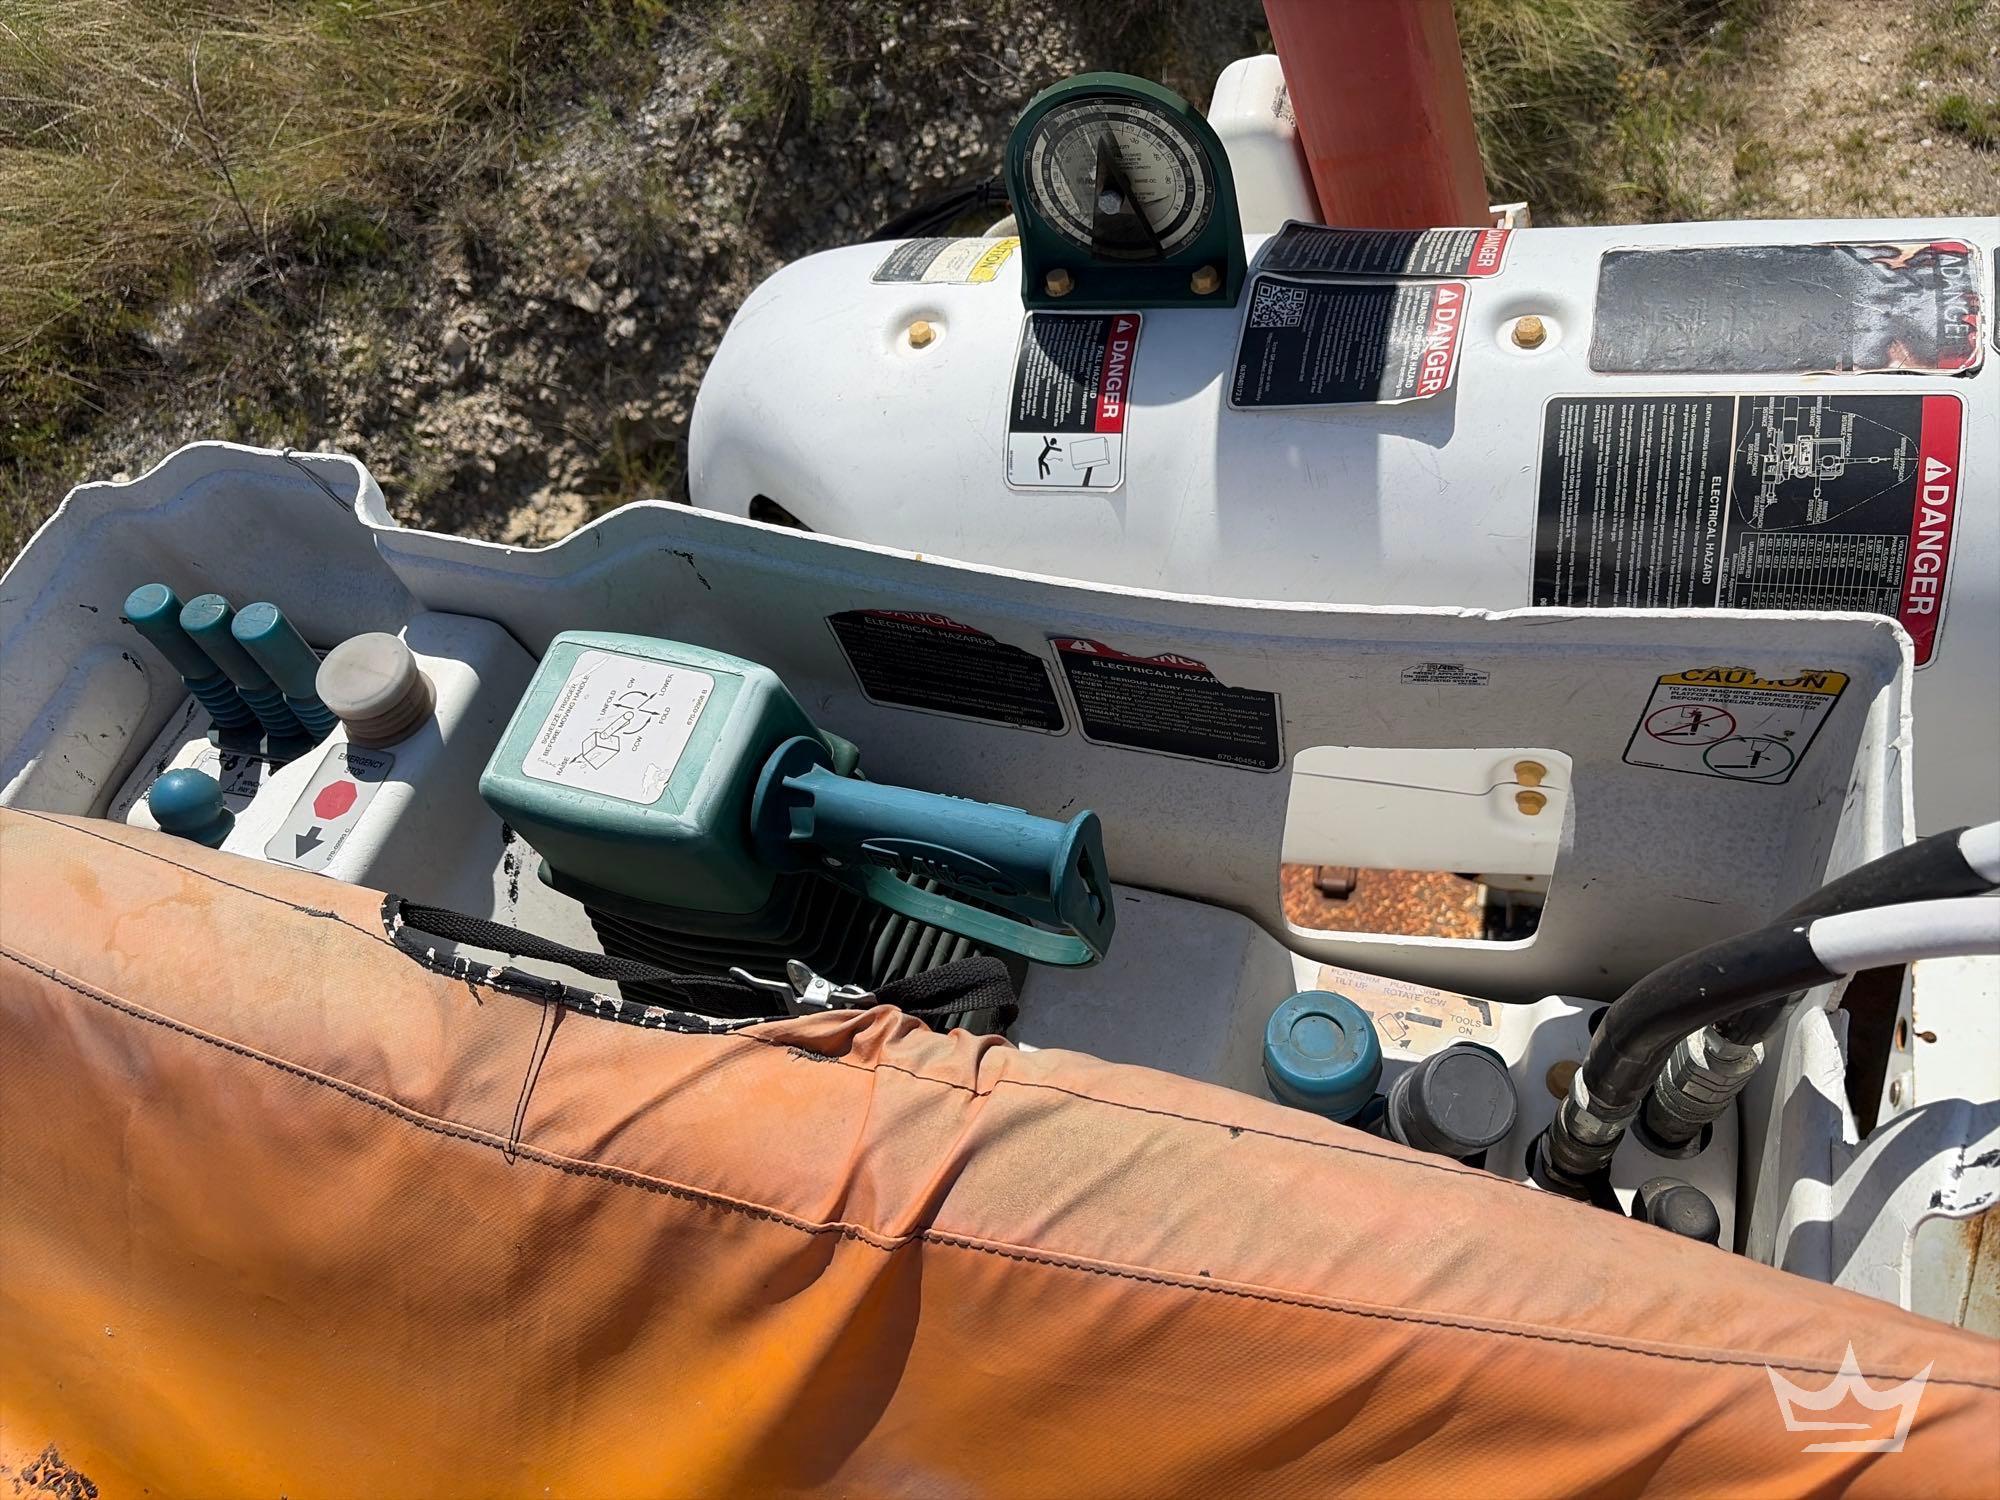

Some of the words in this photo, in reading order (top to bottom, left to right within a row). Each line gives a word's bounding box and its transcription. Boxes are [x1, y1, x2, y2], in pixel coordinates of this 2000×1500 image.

[1415, 291, 1431, 323] UNTRAINED
[1941, 267, 1969, 340] DANGE
[1094, 345, 1104, 363] FALL
[1420, 308, 1457, 394] DANGER
[1088, 365, 1100, 398] HAZARD
[1101, 340, 1129, 418] DANGER
[1403, 361, 1418, 388] HAZARD
[1705, 475, 1722, 540] ELECTRICAL
[1907, 485, 1950, 614] DANGER
[1700, 542, 1715, 584] HAZARD
[864, 616, 934, 635] ELECTRICAL
[1092, 660, 1172, 679] ELECTRICAL
[1174, 672, 1220, 684] HAZAR
[1109, 675, 1149, 685] SERIOUS
[1680, 670, 1829, 689] CAUON
[625, 676, 637, 689] CW
[657, 673, 675, 696] LOWER
[598, 689, 618, 716] UNFOLD
[1754, 691, 1790, 699] DAMAGE
[1793, 693, 1829, 702] RETURN
[1756, 701, 1816, 710] OVERCENTER
[539, 713, 562, 744] SQUEEZE
[556, 682, 578, 713] TRIGGER
[541, 728, 561, 757] BEFORE
[556, 700, 576, 728] MOVING
[571, 674, 590, 701] HANDLE
[657, 706, 672, 724] FOLD
[630, 735, 644, 751] CCW
[337, 752, 384, 769] EMERGENCY
[556, 756, 570, 776] RAISE
[343, 766, 365, 776] STOP
[1383, 988, 1422, 1002] ROTATE
[1449, 1014, 1483, 1028] TOOLS
[1457, 1026, 1473, 1036] ON
